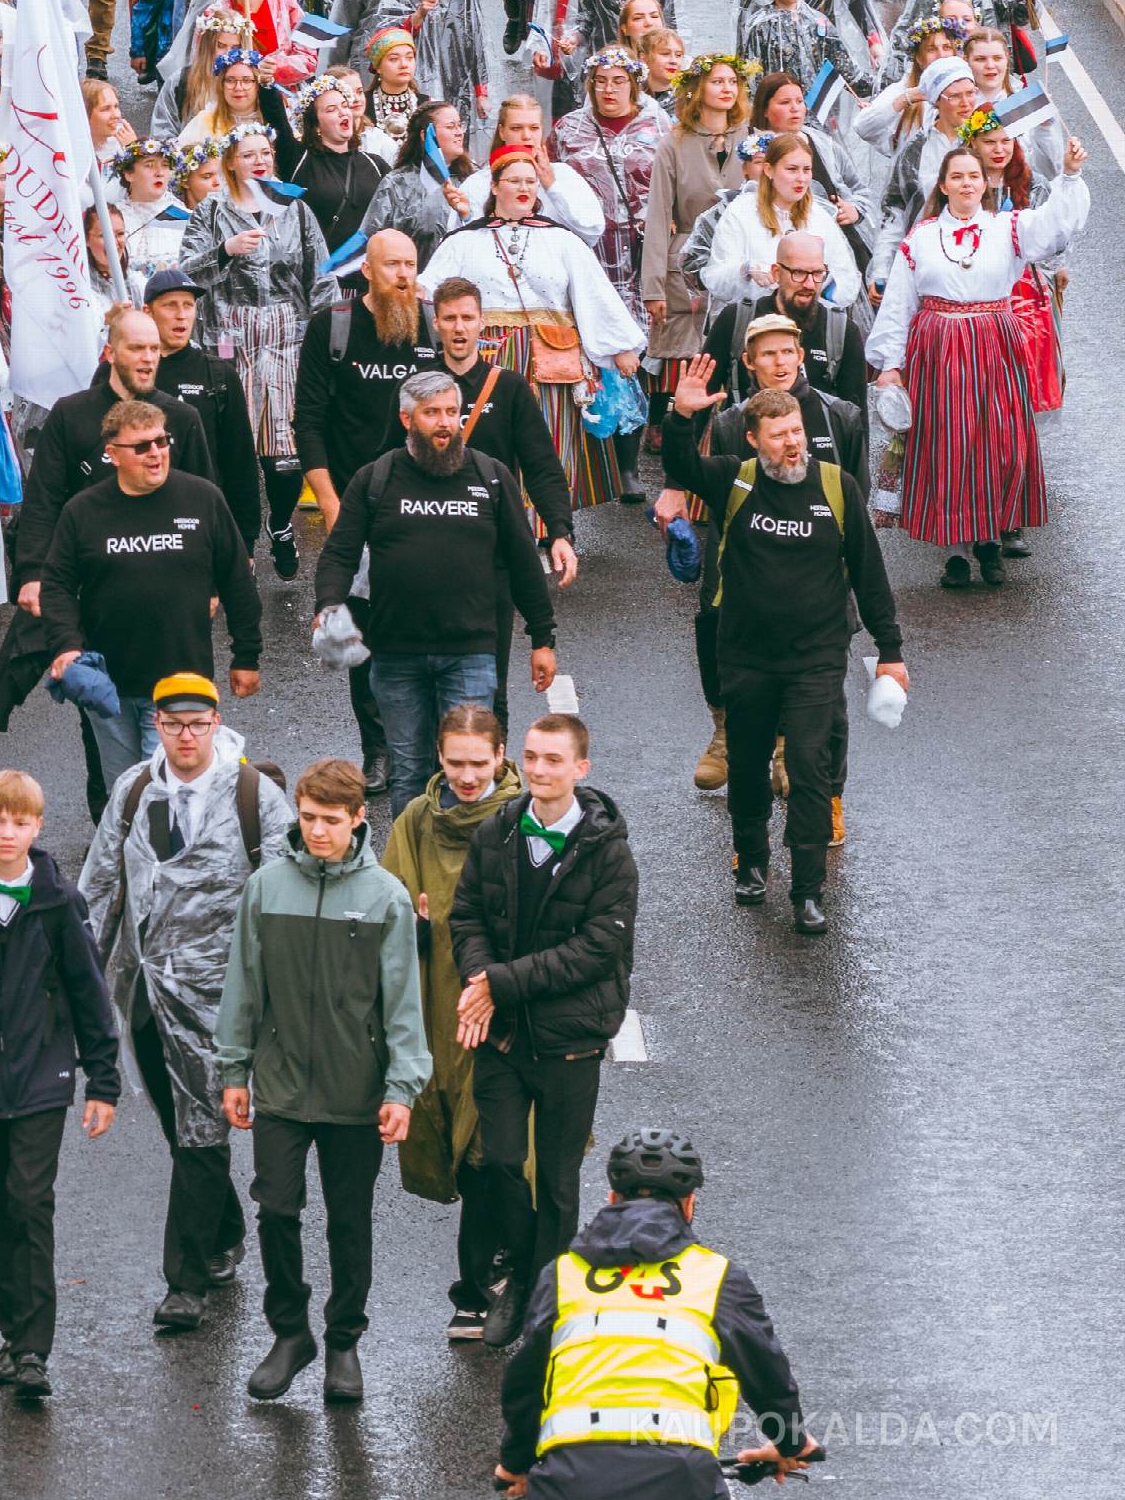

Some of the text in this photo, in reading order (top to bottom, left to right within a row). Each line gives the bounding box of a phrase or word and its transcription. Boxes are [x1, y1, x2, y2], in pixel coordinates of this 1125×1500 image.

[36, 252, 91, 310] 1996
[357, 363, 419, 380] VALGA
[400, 499, 479, 517] RAKVERE
[750, 512, 813, 538] KOERU
[106, 533, 184, 555] RAKVERE
[585, 1261, 682, 1301] G4S
